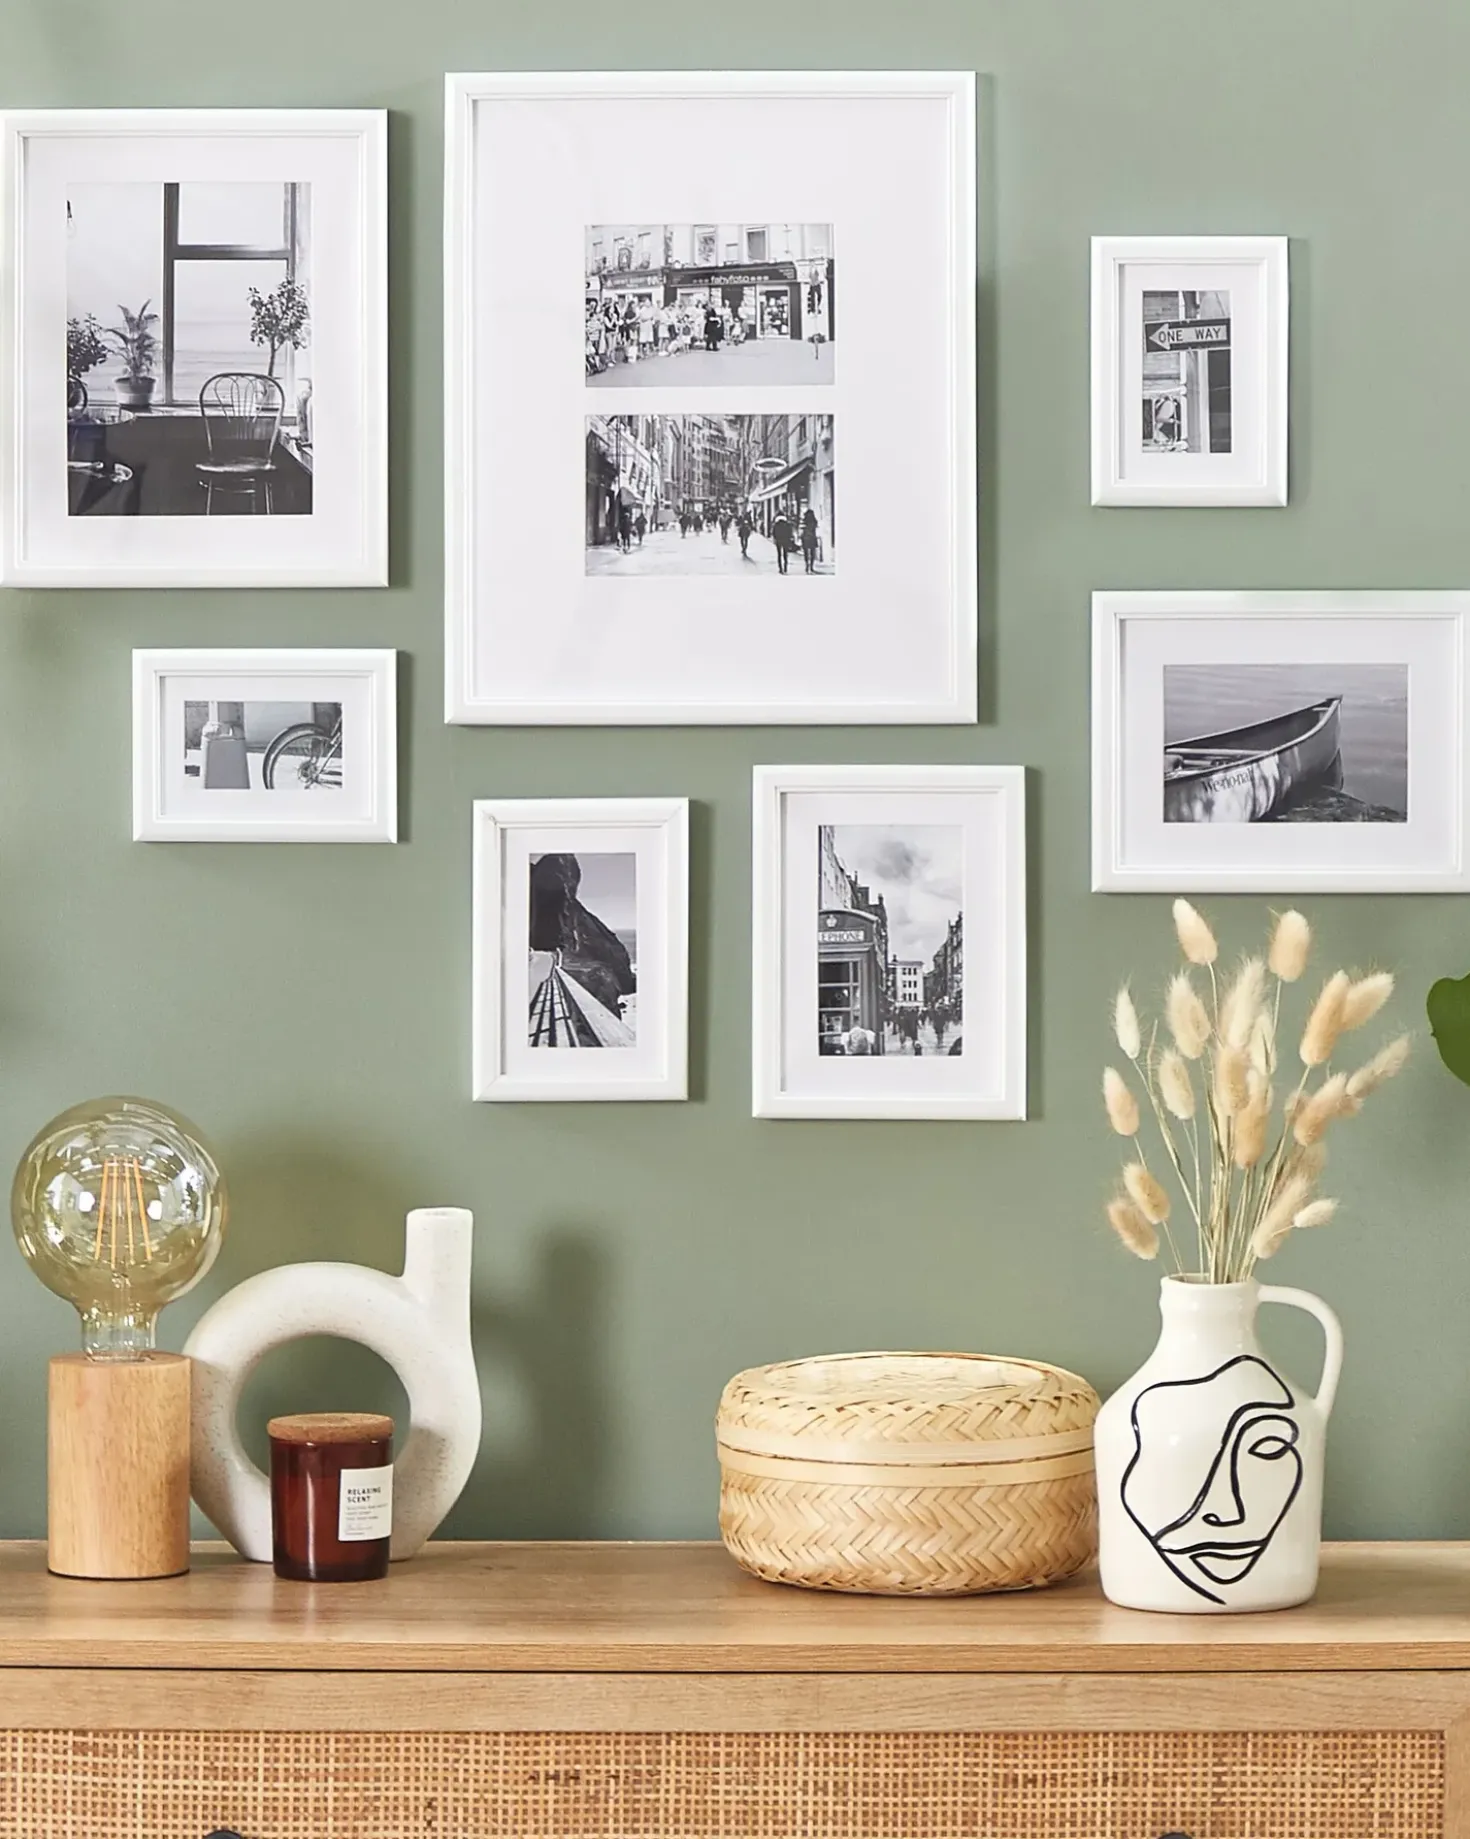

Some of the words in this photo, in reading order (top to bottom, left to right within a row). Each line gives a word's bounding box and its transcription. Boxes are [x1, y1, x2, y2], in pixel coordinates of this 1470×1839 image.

[1158, 330, 1184, 343] ONE
[1195, 328, 1222, 340] WAY
[347, 1487, 381, 1495] RELAXING
